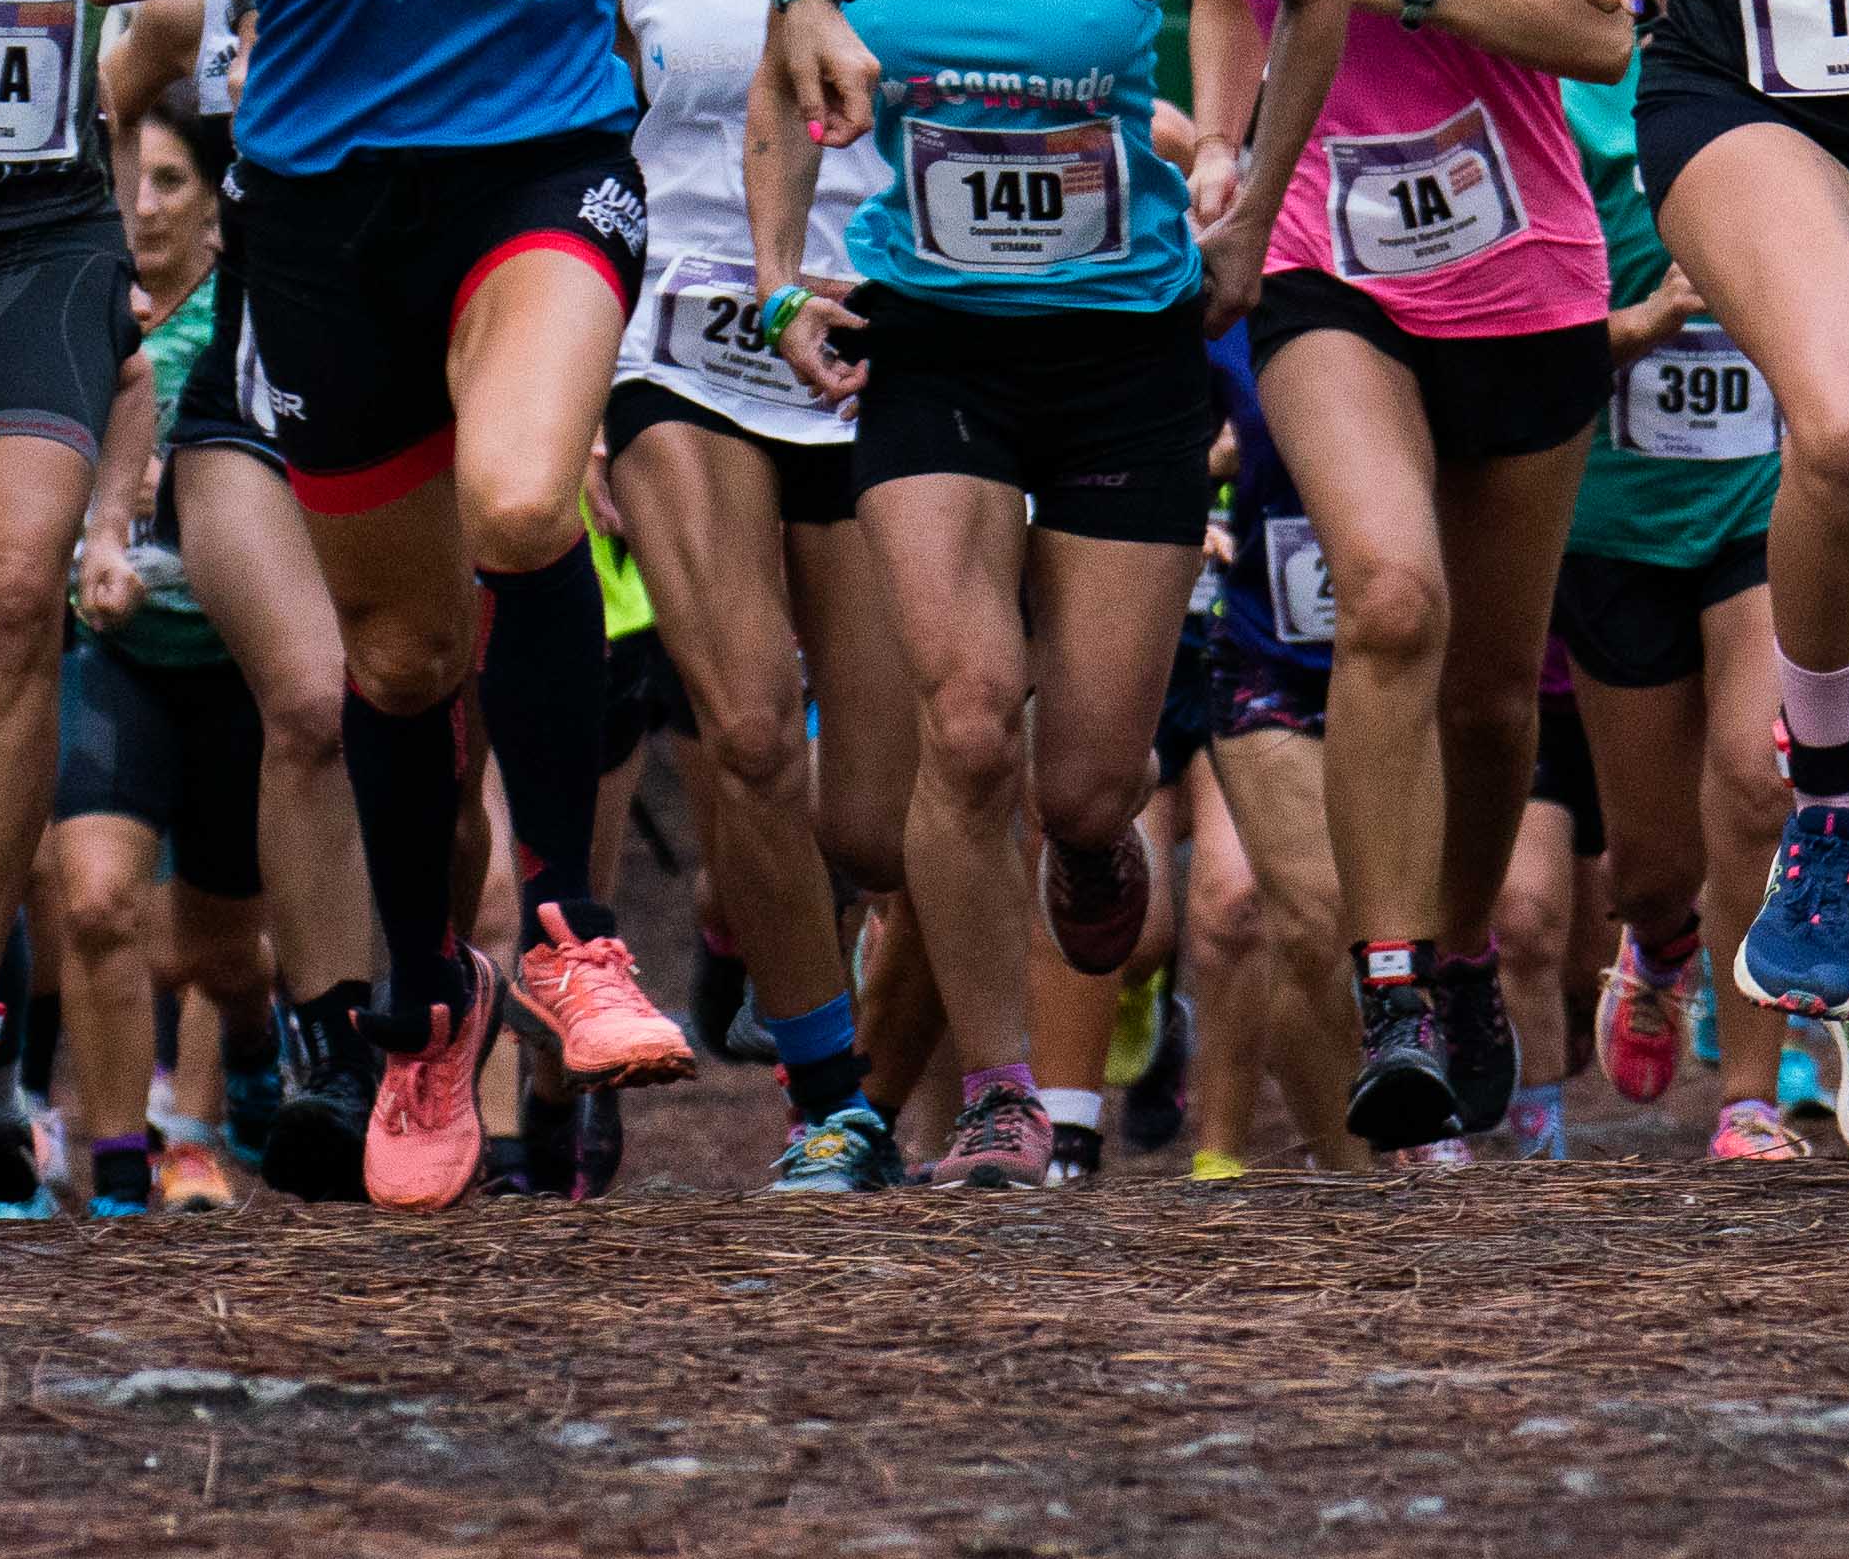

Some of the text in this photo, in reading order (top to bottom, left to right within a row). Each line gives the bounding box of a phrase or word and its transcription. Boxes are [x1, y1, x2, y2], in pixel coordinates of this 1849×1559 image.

[961, 170, 1064, 222] 14D
[1388, 175, 1455, 230] 1A
[702, 296, 773, 354] 29
[1656, 364, 1750, 415] 39D
